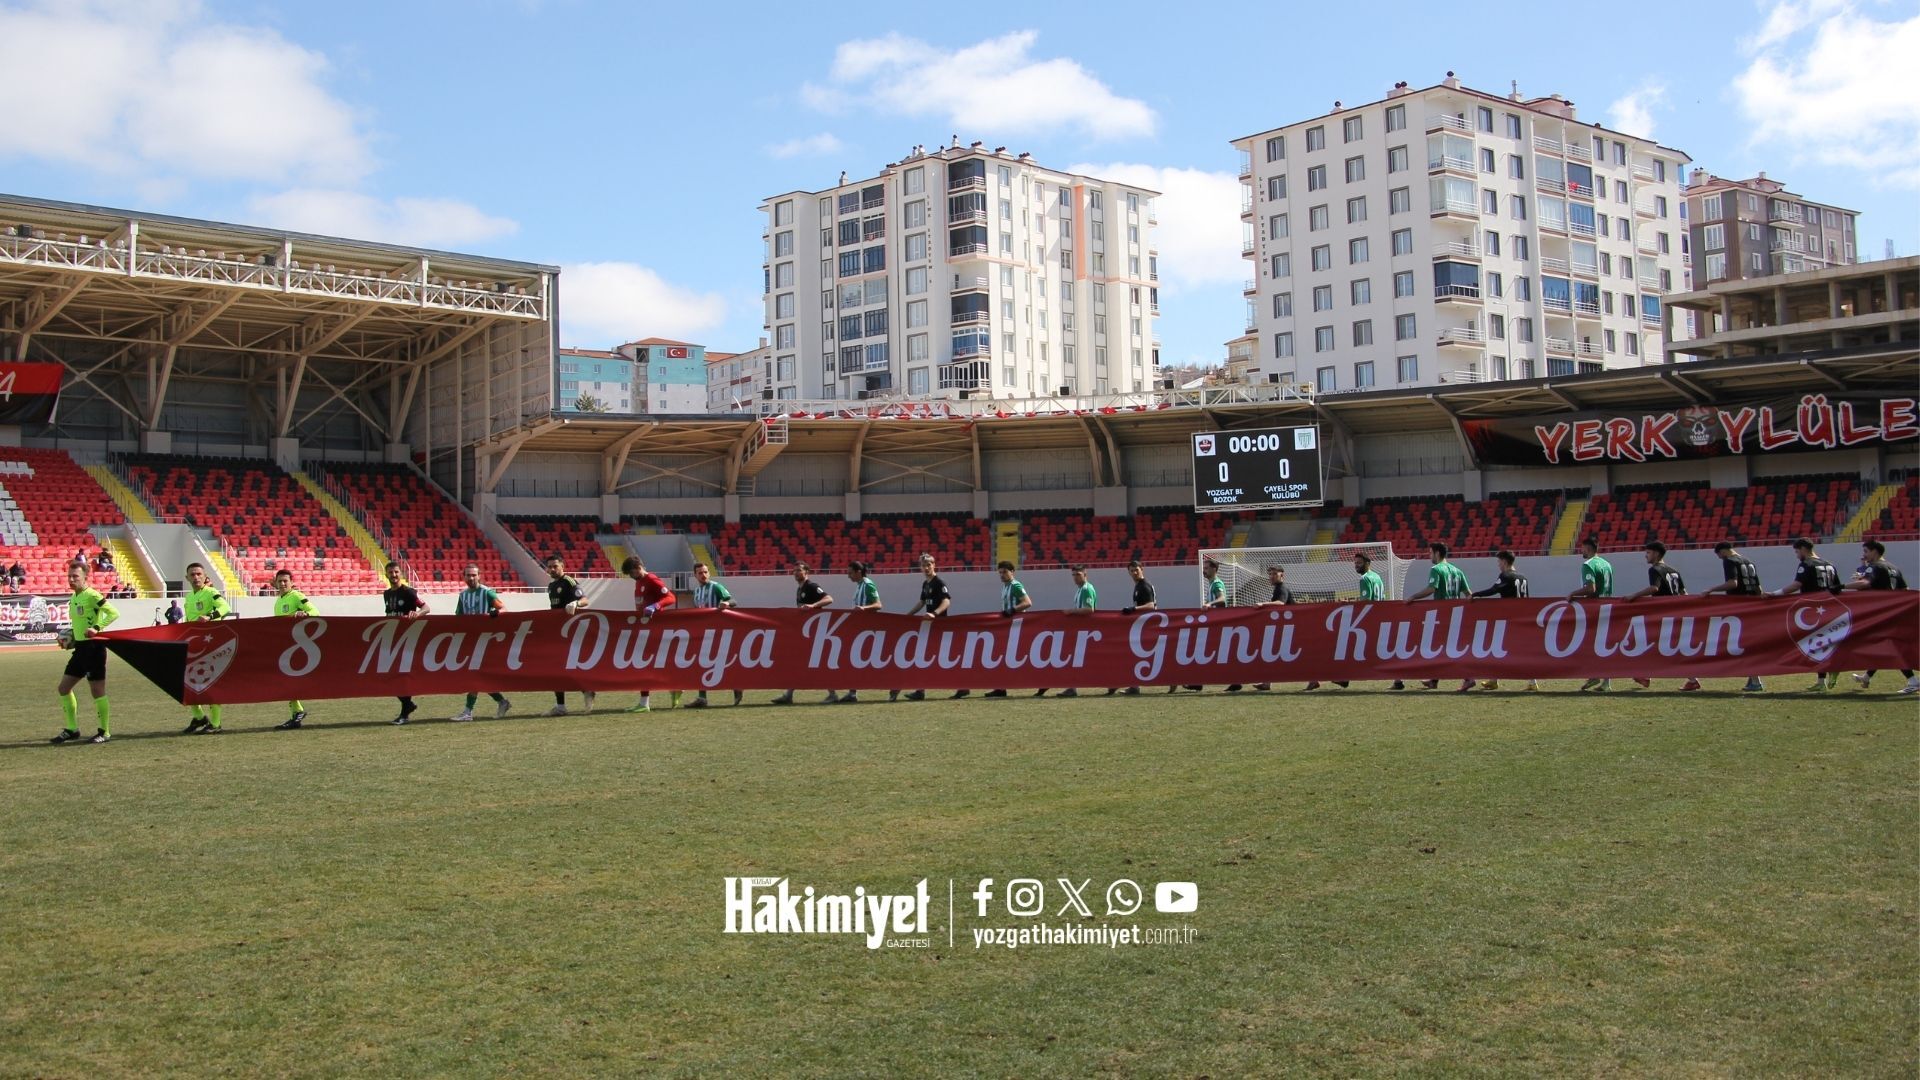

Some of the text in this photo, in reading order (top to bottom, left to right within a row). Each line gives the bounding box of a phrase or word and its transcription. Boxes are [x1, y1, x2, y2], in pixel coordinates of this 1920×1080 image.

[1229, 434, 1280, 453] 00:00
[1218, 462, 1229, 483] 0
[1279, 458, 1290, 479] 0
[1206, 488, 1233, 497] YOZGAT
[1263, 483, 1308, 493] ÇAYELİ SPOR
[1271, 491, 1300, 499] KULÜBÜ
[279, 601, 1743, 688] 8 Mart Dünya Kadınlar Günü Kutlu Olsun
